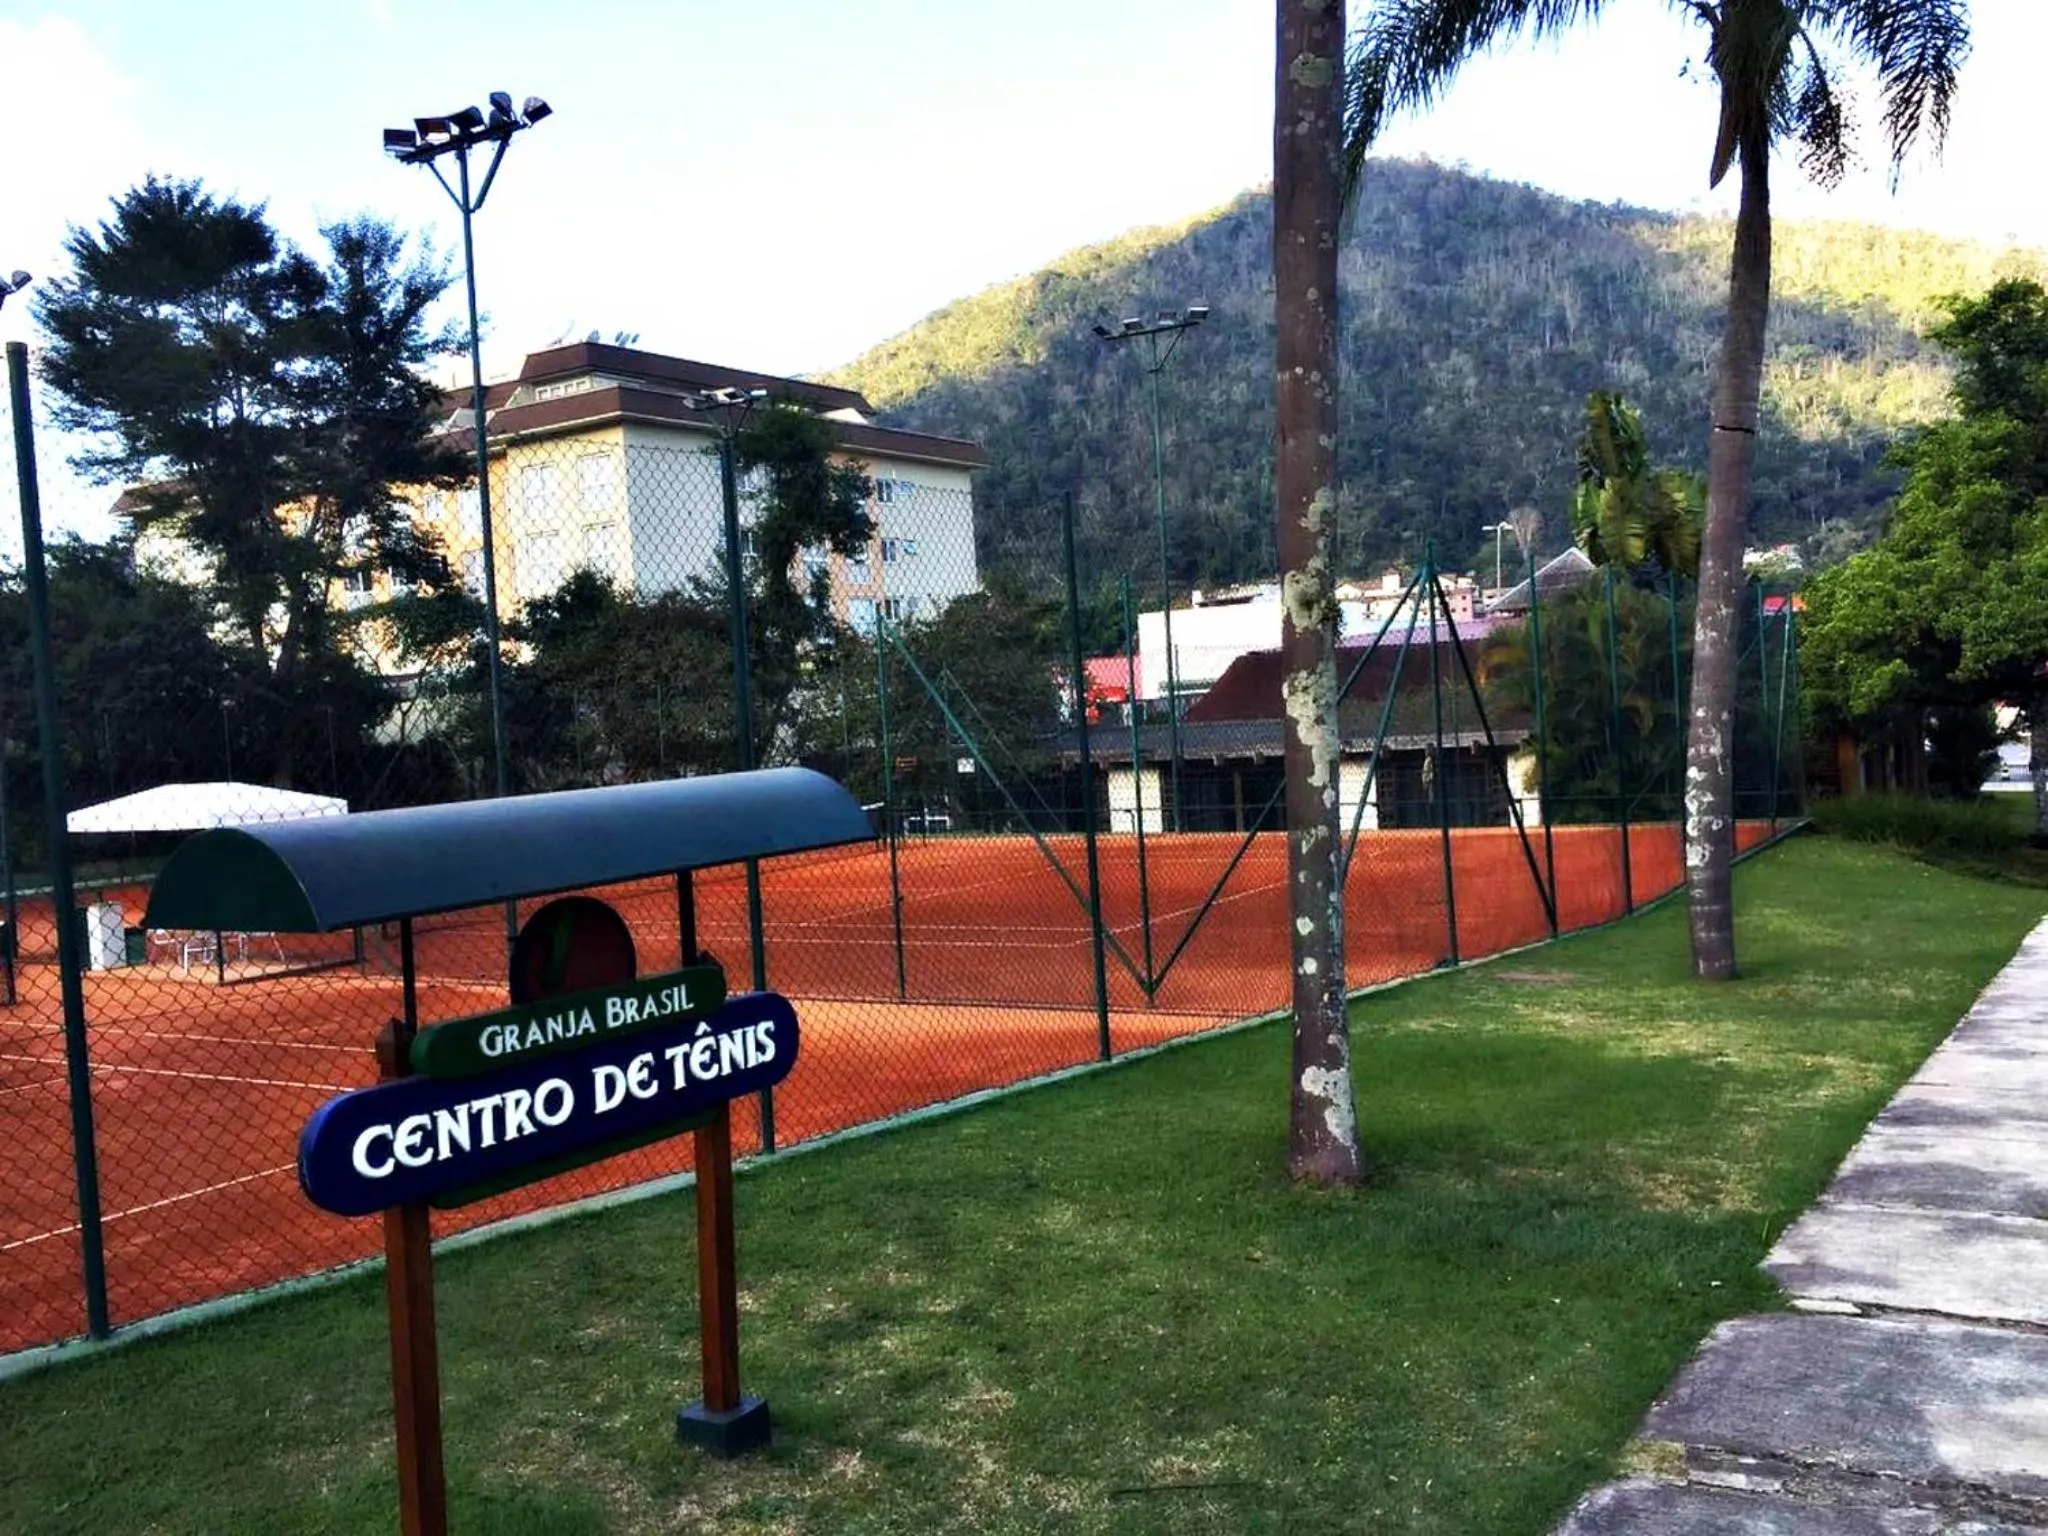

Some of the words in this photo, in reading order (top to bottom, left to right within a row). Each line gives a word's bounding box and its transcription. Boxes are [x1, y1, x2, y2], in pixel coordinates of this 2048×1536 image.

[479, 1007, 596, 1057] GRANJA
[606, 985, 694, 1028] BRASIL
[352, 1078, 574, 1178] CENTRO
[591, 1052, 659, 1114] DE
[665, 1021, 776, 1090] TÊNIS
